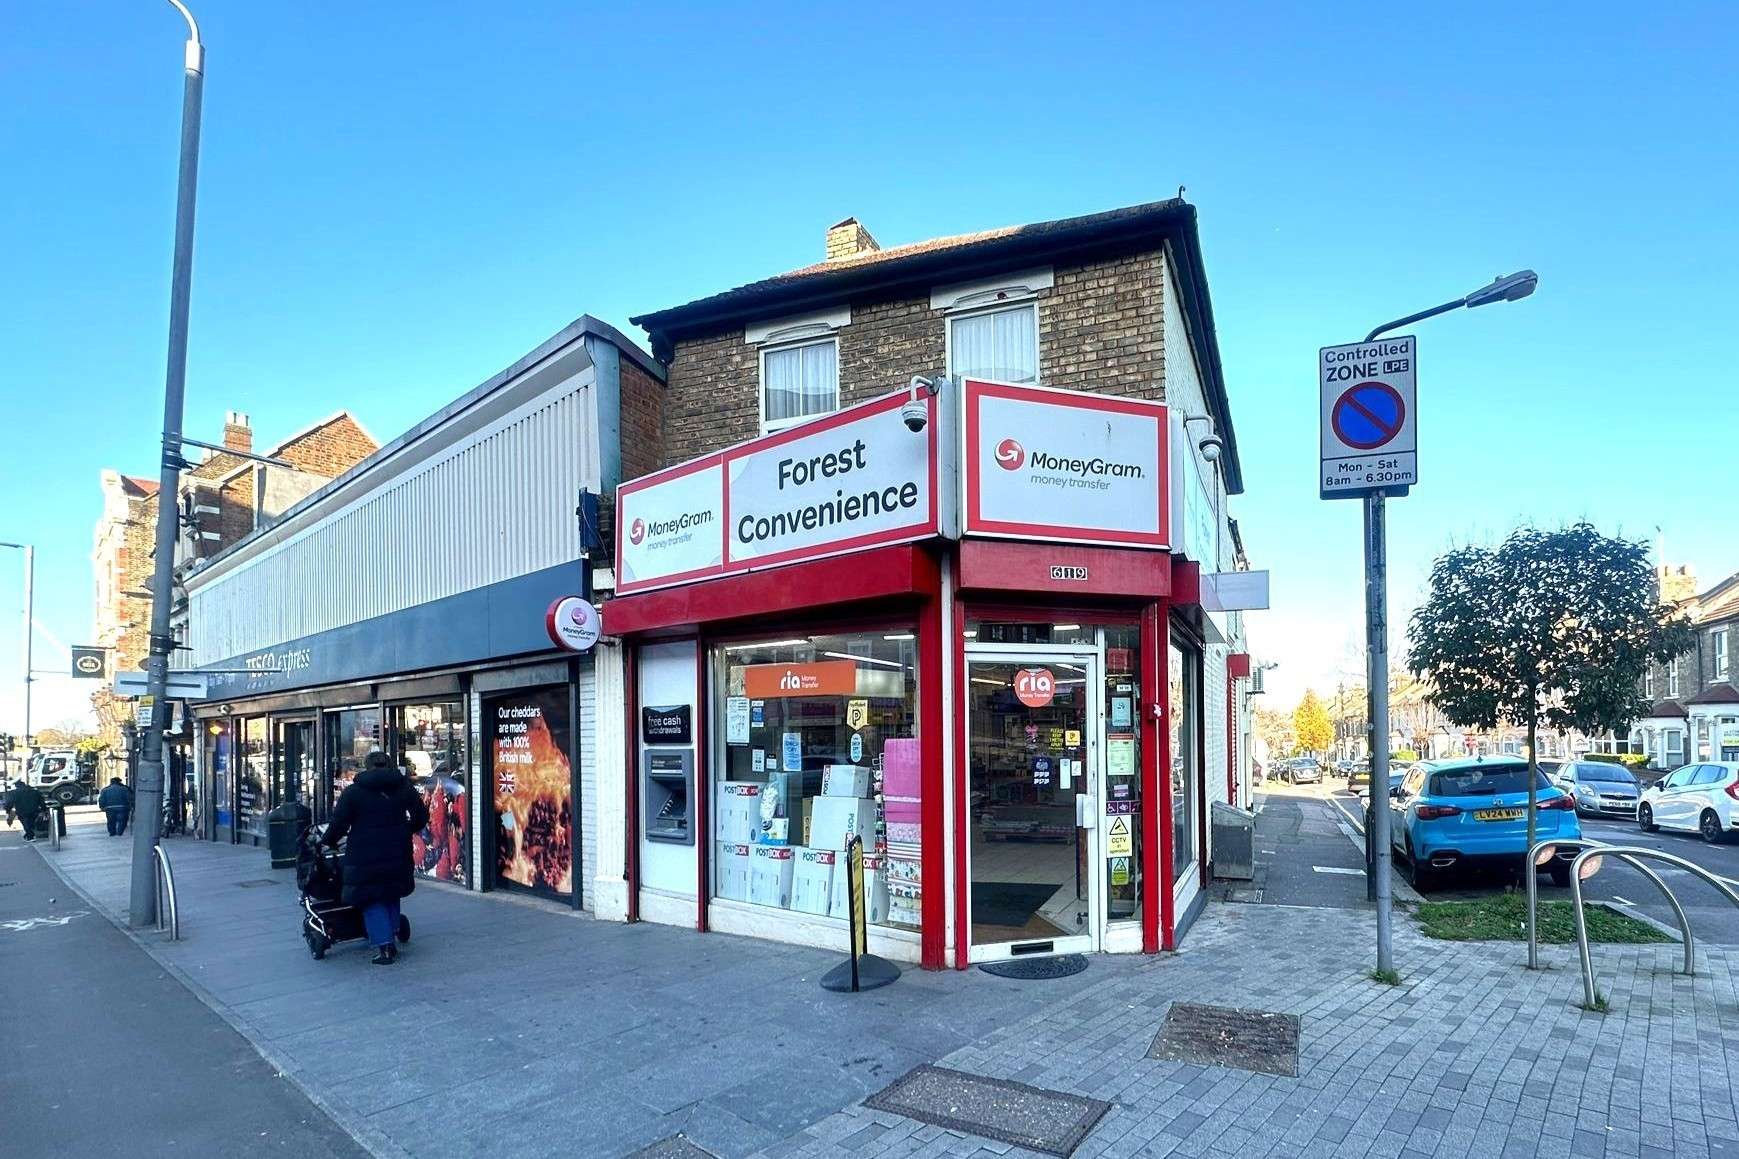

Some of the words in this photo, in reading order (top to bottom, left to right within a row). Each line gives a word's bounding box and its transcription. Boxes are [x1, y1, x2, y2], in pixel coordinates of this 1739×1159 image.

[1325, 341, 1409, 363] Controlled
[1326, 362, 1378, 382] ZONE
[1384, 360, 1408, 373] LPE
[778, 439, 866, 490] Forest
[1031, 452, 1142, 478] MoneyGram
[1338, 463, 1362, 472] Mon
[1378, 460, 1398, 469] Sat
[1031, 475, 1067, 488] money
[1069, 478, 1110, 490] transfer
[1326, 477, 1350, 486] 8am
[1366, 471, 1412, 484] 6.30pm
[738, 482, 918, 543] Convenience
[647, 509, 712, 538] MoneyGram
[1052, 566, 1087, 579] 619
[563, 626, 596, 636] MoneyGram
[246, 652, 275, 677] TESCO
[278, 648, 310, 679] express
[780, 670, 800, 689] ria
[1019, 673, 1051, 691] ria
[498, 706, 510, 718] Our
[511, 705, 541, 718] cheddars
[498, 724, 509, 733] are
[510, 721, 527, 733] made
[663, 715, 681, 726] cash
[499, 736, 512, 748] with
[513, 736, 530, 748] 100%
[499, 751, 518, 763] British
[519, 751, 533, 763] milk
